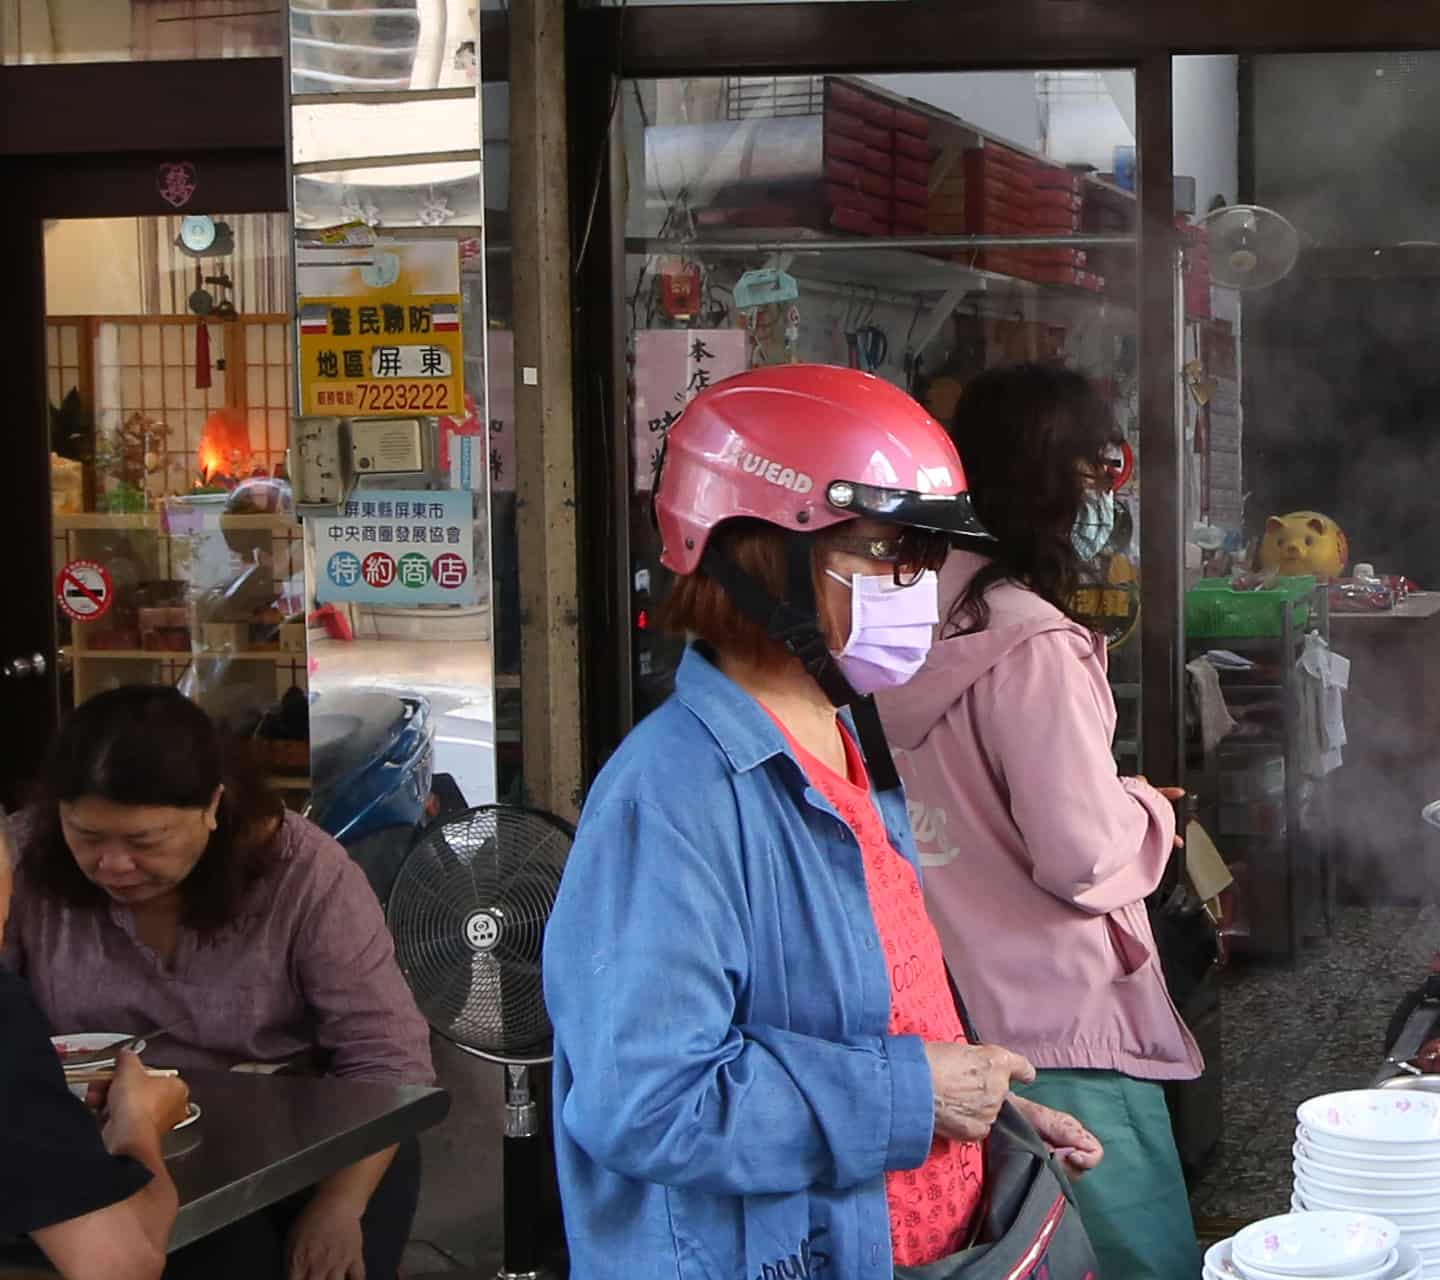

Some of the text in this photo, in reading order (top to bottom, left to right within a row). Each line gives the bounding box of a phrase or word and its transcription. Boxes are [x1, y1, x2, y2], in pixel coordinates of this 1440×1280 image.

[331, 305, 431, 336] 警民聯防
[356, 383, 448, 411] 7223222
[344, 501, 444, 519] 屏東縣屏東市
[328, 525, 462, 544] 中央商圈發展協會
[329, 554, 465, 586] 特約商店
